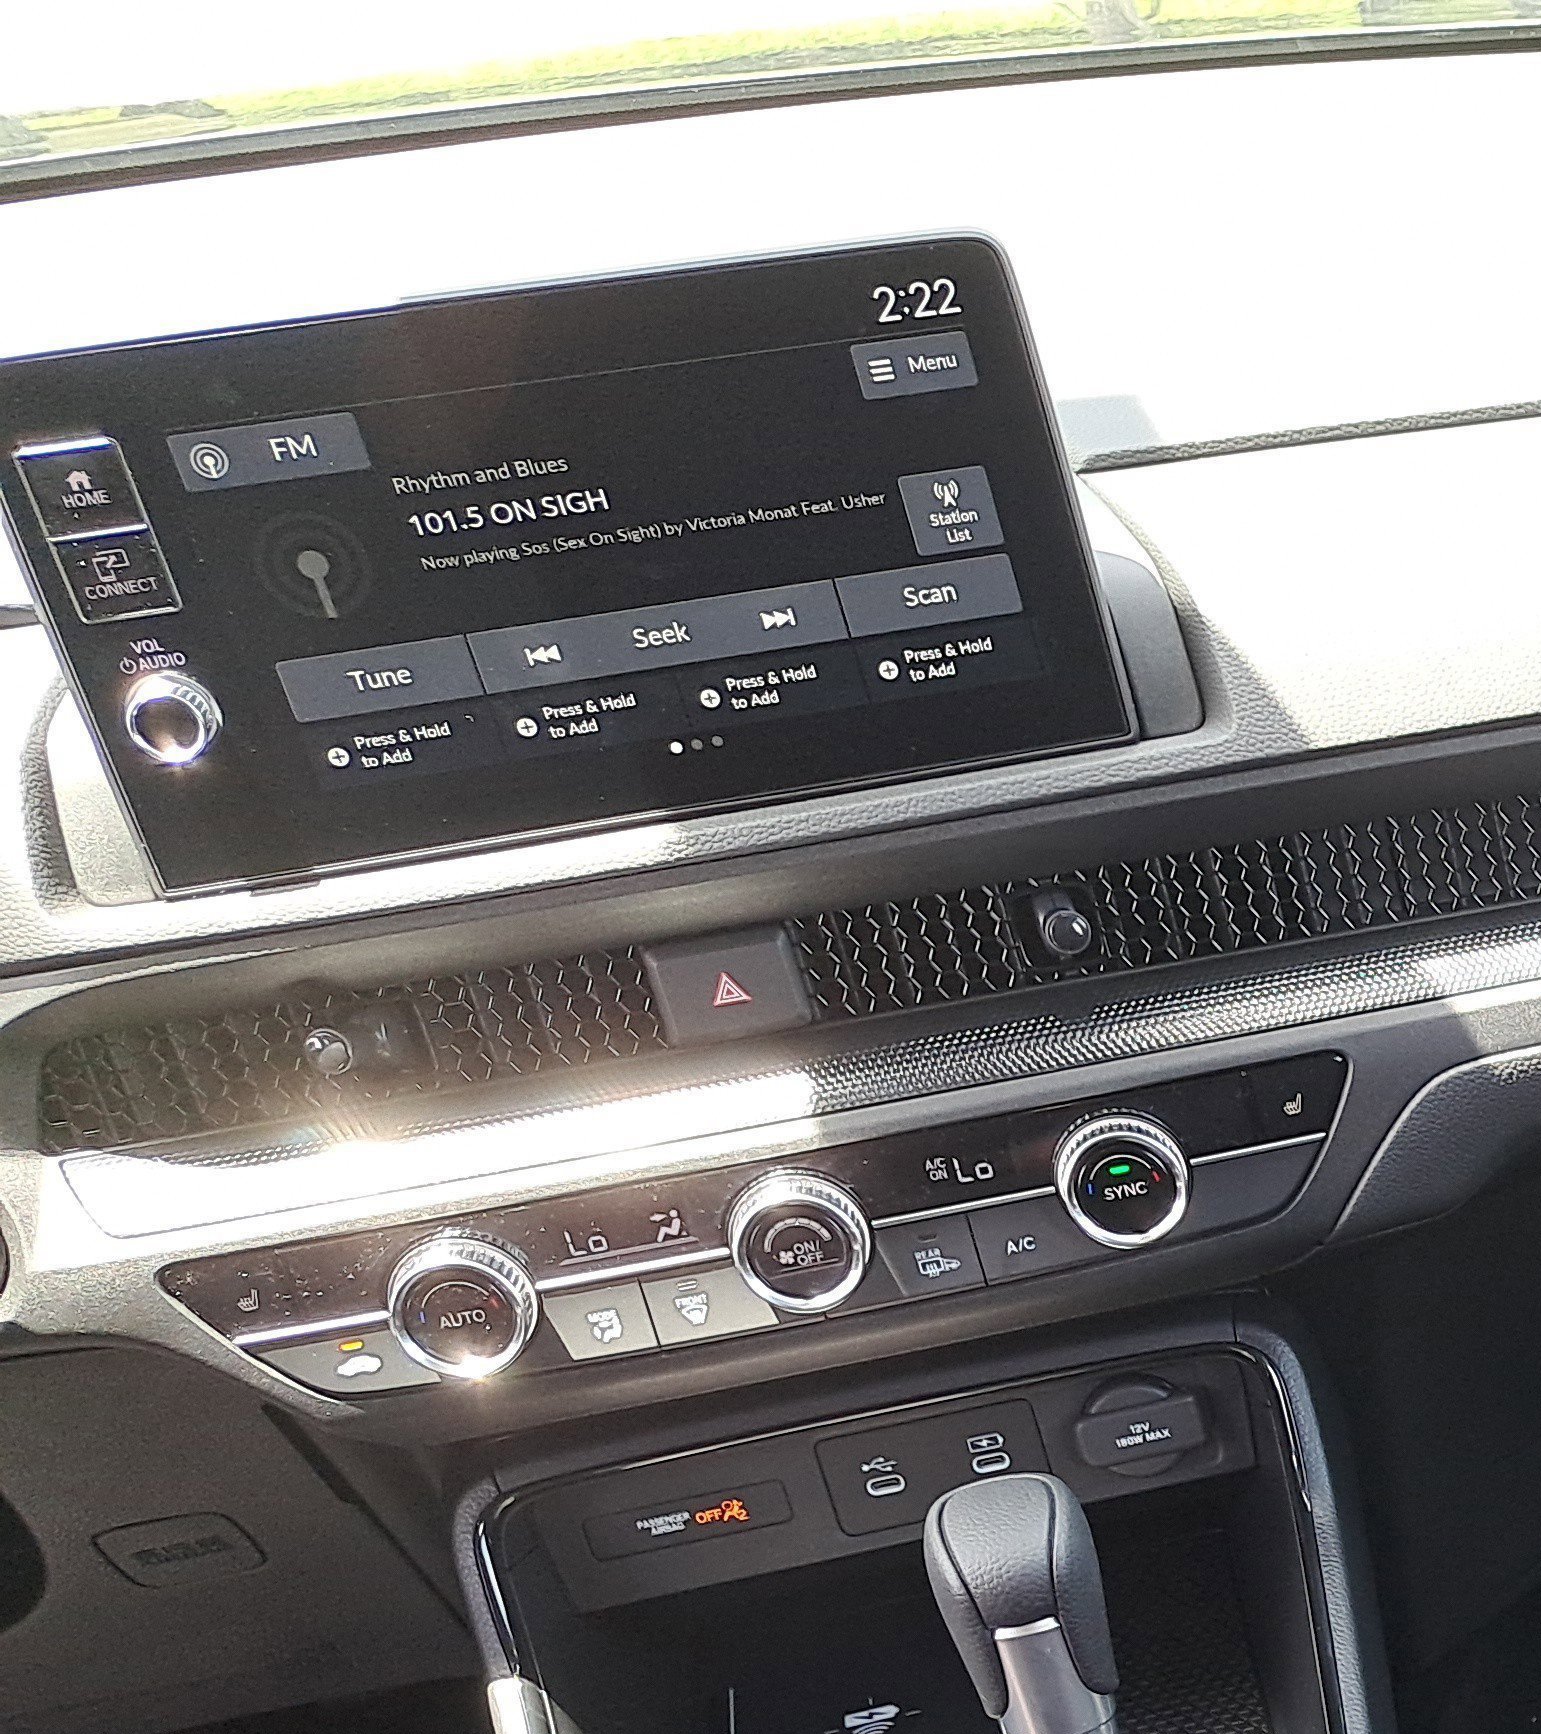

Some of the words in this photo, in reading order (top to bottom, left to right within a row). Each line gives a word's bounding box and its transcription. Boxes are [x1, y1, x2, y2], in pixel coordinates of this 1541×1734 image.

[872, 278, 962, 323] 2:22
[907, 353, 958, 374] Menu
[268, 434, 319, 461] FM
[391, 471, 471, 495] Rhythm
[474, 462, 511, 484] and
[513, 458, 569, 478] Blues
[61, 489, 112, 509] HOME
[408, 506, 484, 536] 101.5
[490, 498, 537, 524] ON
[541, 488, 610, 517] SIGH
[929, 509, 979, 528] Station
[420, 554, 460, 571] Now
[463, 546, 521, 568] playing
[521, 541, 550, 556] Sos
[553, 536, 588, 553] (Sex
[589, 531, 615, 546] On
[617, 523, 662, 543] Sight)
[664, 521, 683, 537] by
[685, 512, 746, 532] Victoria
[749, 504, 799, 523] Monat
[800, 500, 838, 516] Feat.
[841, 493, 886, 510] Usher
[946, 528, 973, 543] List
[84, 576, 159, 600] CONNECT
[903, 584, 958, 607] Scan
[129, 637, 165, 654] VOL
[631, 622, 692, 650] Seek
[904, 648, 942, 664] Press
[944, 643, 958, 657] &
[959, 637, 993, 655] Hold
[139, 652, 186, 671] AUDIO
[345, 667, 413, 691] Tune
[725, 675, 765, 692] Press
[767, 671, 781, 685] &
[783, 664, 818, 683] Hold
[909, 669, 926, 682] to
[928, 662, 956, 680] Add
[541, 703, 583, 720] Press
[585, 699, 599, 714] &
[600, 693, 637, 711] Hold
[730, 696, 748, 710] to
[751, 691, 780, 707] Add
[353, 733, 396, 750] Press
[398, 729, 413, 743] &
[415, 722, 452, 740] Hold
[547, 725, 566, 739] to
[568, 719, 600, 736] Add
[361, 754, 379, 768] to
[381, 749, 413, 766] Add
[925, 1157, 948, 1172] A/C
[953, 1158, 994, 1185] Lo
[929, 1169, 949, 1182] ON
[1103, 1181, 1149, 1201] SYNC
[563, 1229, 609, 1257] Lo
[793, 1241, 821, 1256] ON/
[1005, 1236, 1037, 1256] A/C
[796, 1253, 825, 1267] OFF
[914, 1248, 942, 1261] REAR
[674, 1292, 708, 1308] FRONT
[440, 1309, 487, 1329] AUTO
[1129, 1421, 1150, 1434] 12V
[1145, 1427, 1172, 1442] MAX
[695, 1508, 722, 1524] OFF
